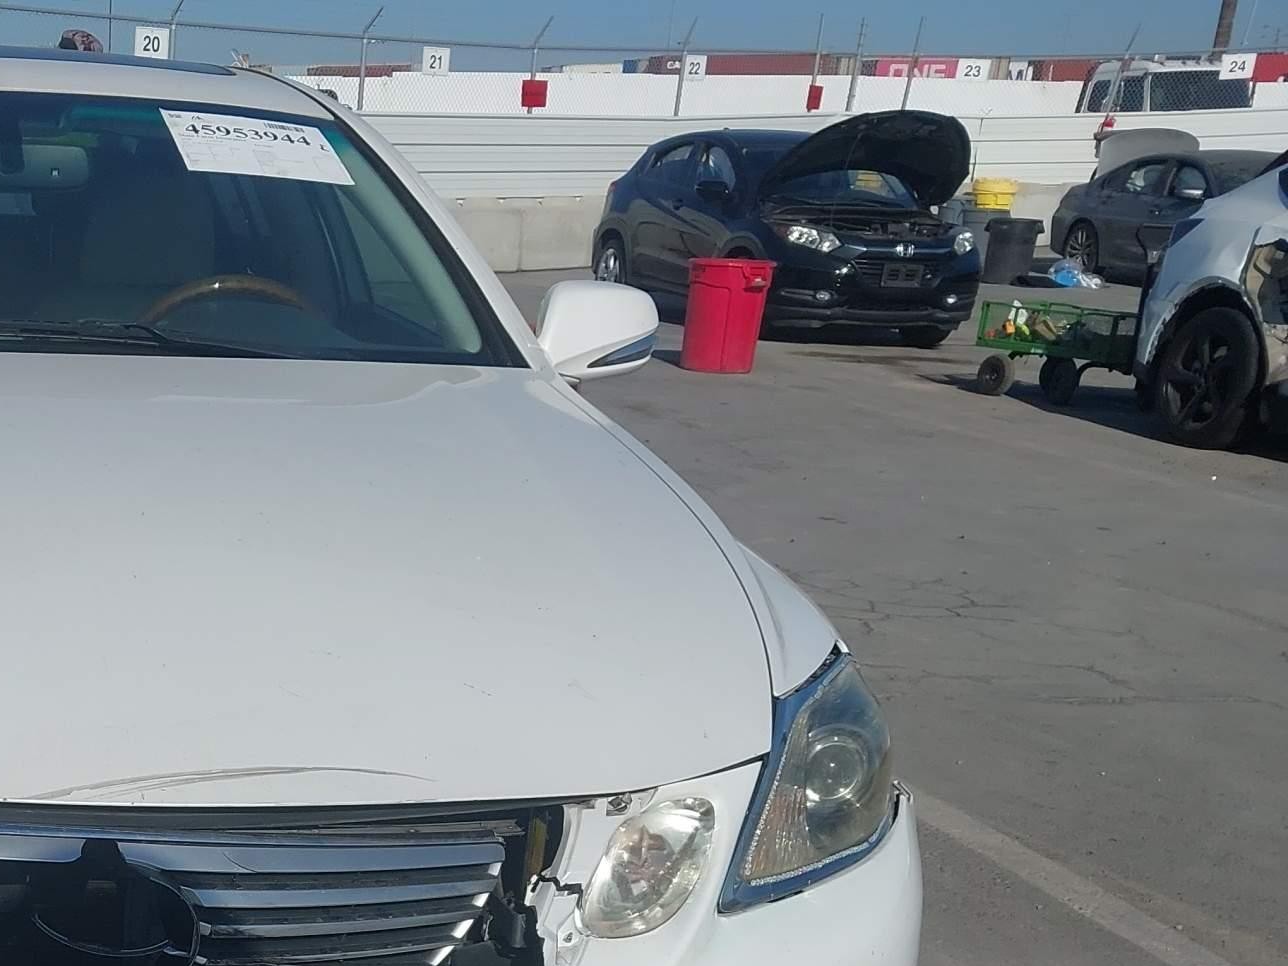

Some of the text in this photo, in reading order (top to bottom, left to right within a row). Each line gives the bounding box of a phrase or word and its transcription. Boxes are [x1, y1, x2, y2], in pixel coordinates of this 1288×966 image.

[143, 35, 160, 52] 20
[429, 54, 443, 69] 21
[688, 62, 701, 75] 22
[1228, 60, 1247, 73] 24
[963, 64, 982, 77] 23
[185, 123, 312, 146] 45953944
